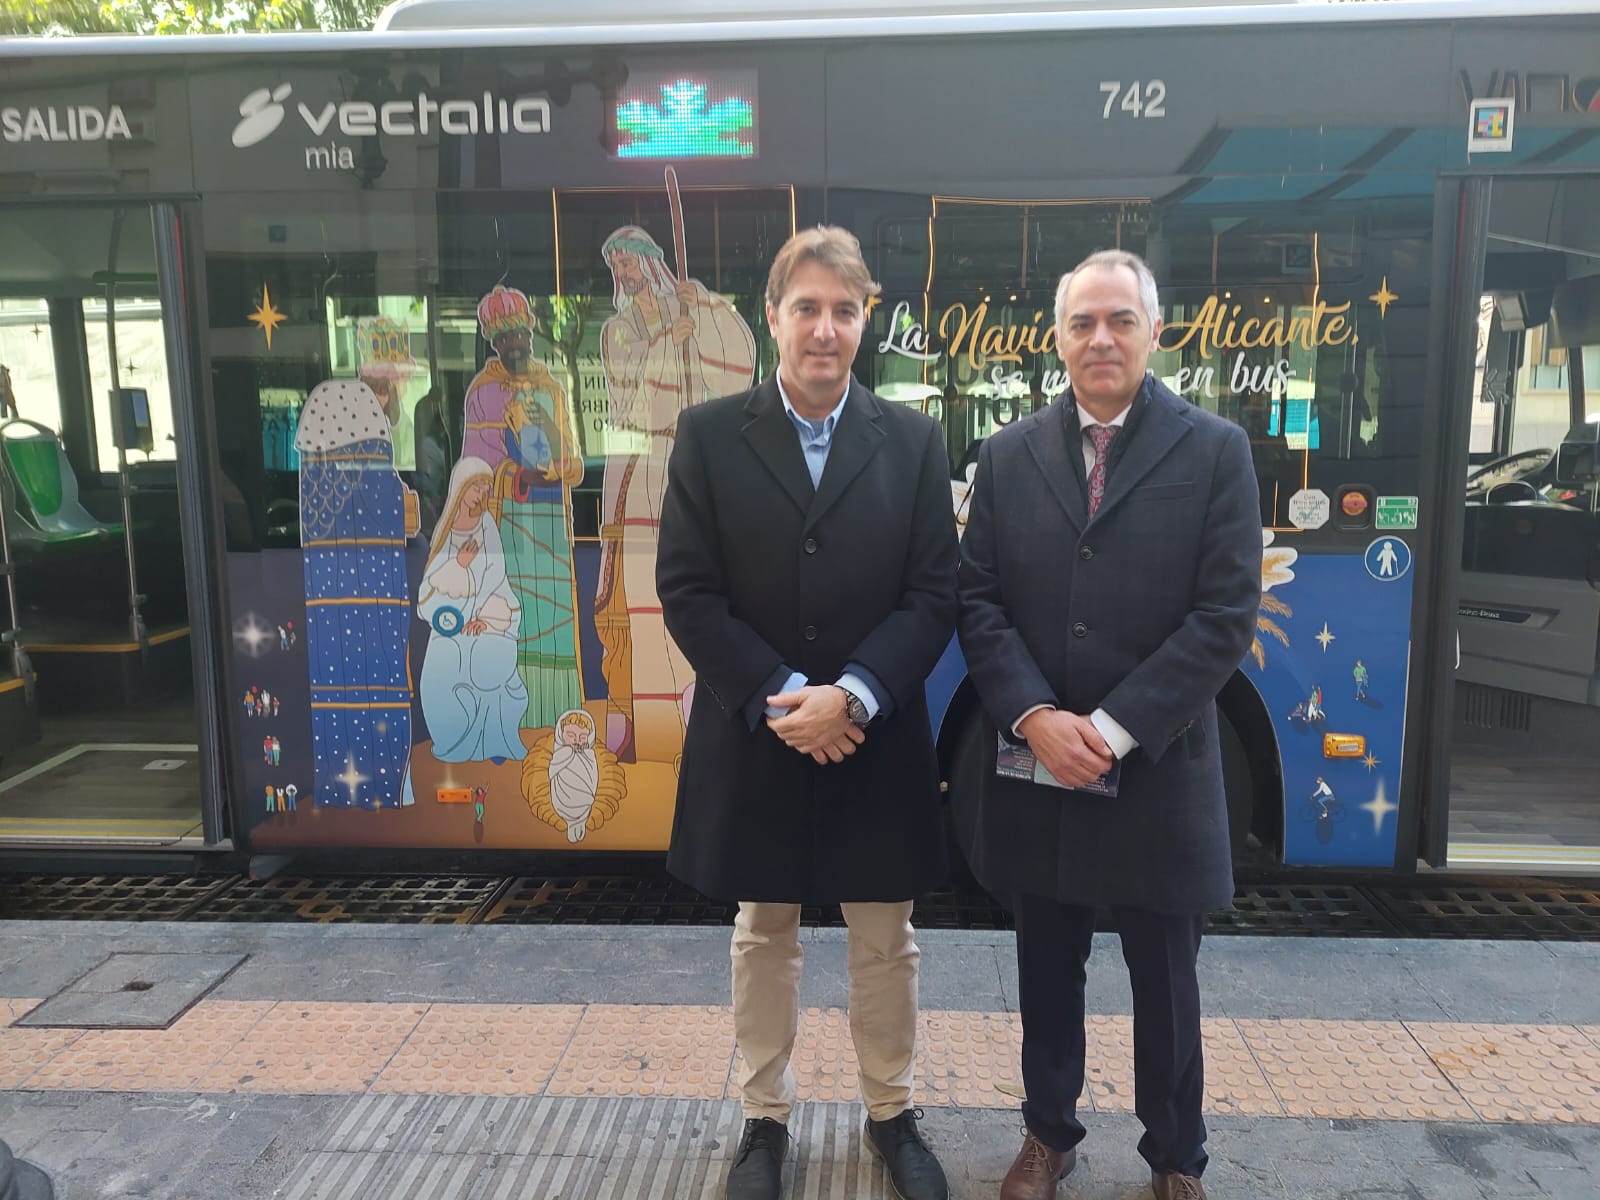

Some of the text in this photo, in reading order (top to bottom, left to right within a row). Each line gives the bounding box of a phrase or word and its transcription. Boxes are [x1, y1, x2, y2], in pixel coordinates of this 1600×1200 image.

[298, 91, 552, 136] vectalia
[1099, 79, 1167, 120] 742
[1, 105, 133, 142] SALIDA
[304, 142, 355, 169] mia
[878, 301, 941, 360] La
[1159, 295, 1359, 360] Alicante,
[990, 365, 1023, 400] se
[1173, 365, 1215, 398] en
[1230, 351, 1297, 394] bus
